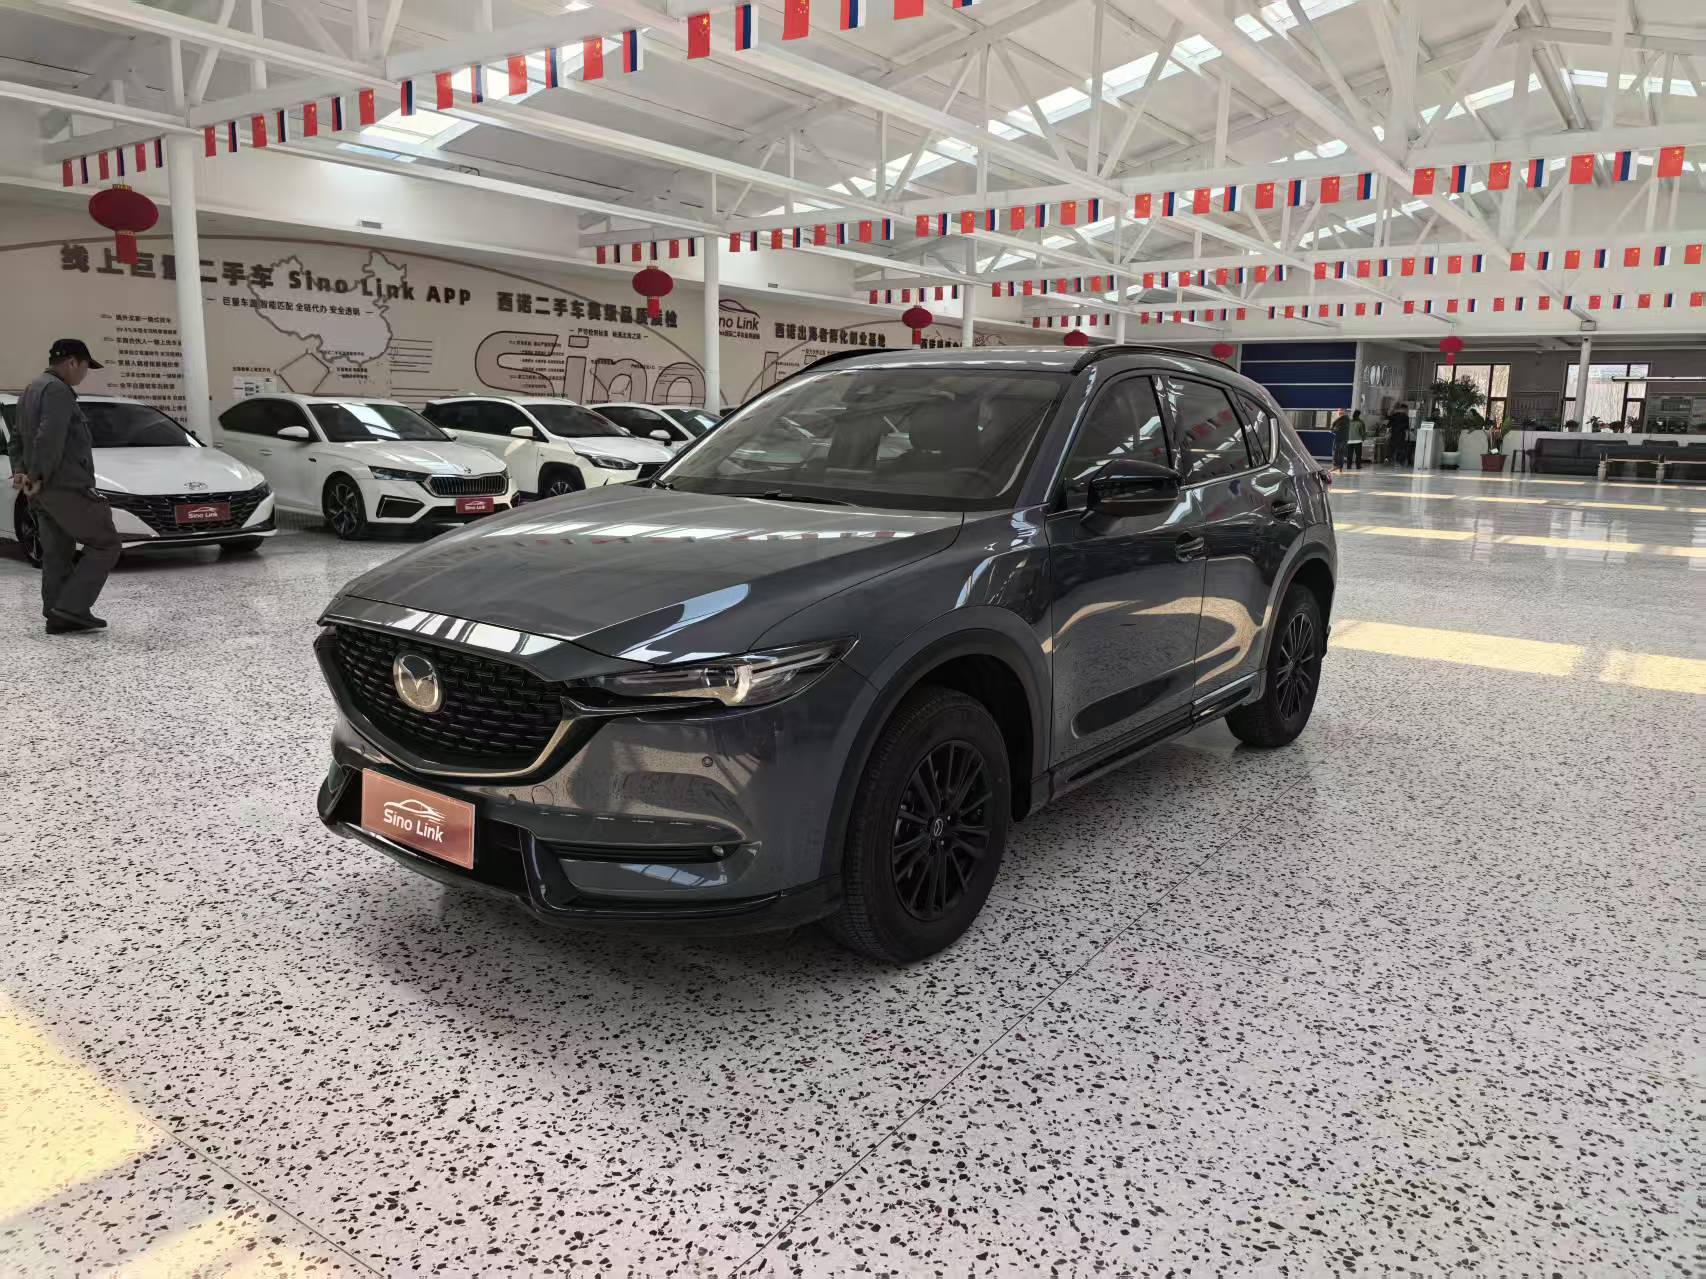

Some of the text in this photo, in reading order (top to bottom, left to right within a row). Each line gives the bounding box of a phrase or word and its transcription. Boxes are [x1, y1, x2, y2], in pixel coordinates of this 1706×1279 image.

[288, 269, 349, 294] Sino
[361, 277, 415, 301] Link
[426, 285, 471, 305] APP
[737, 316, 759, 331] Link
[383, 808, 445, 843] Sino Link
